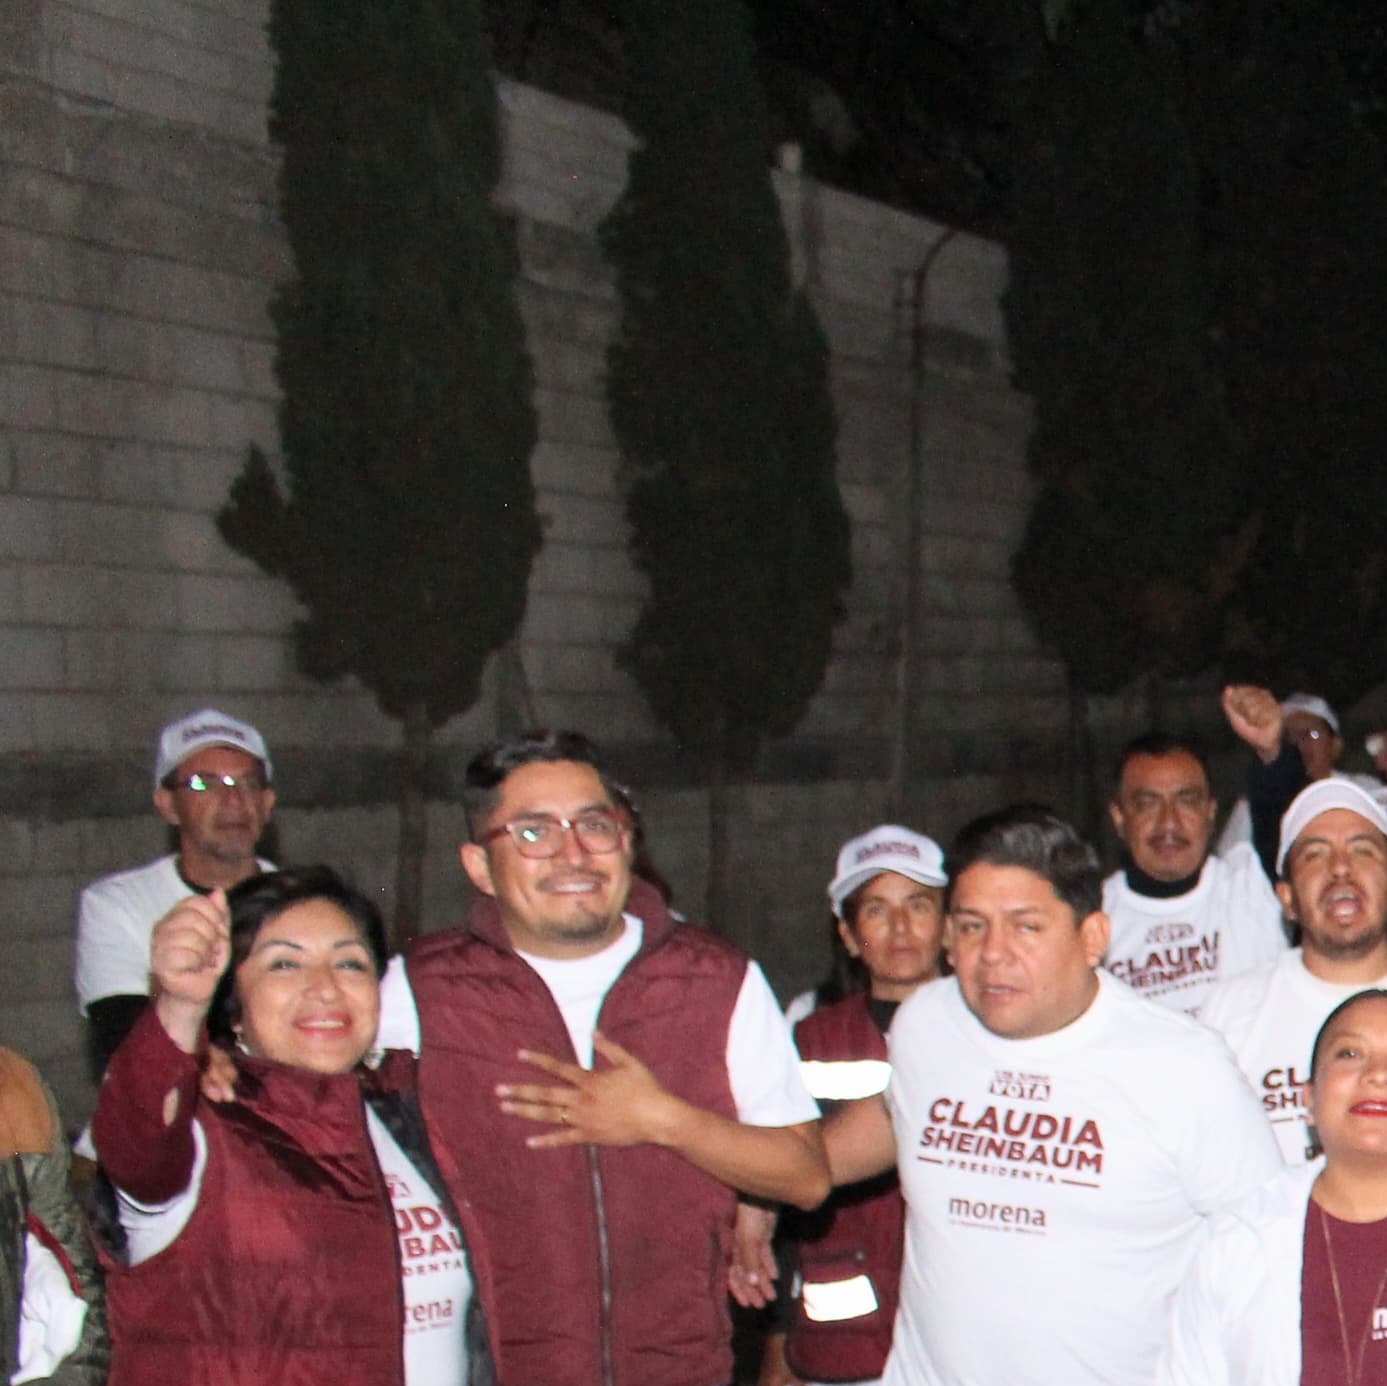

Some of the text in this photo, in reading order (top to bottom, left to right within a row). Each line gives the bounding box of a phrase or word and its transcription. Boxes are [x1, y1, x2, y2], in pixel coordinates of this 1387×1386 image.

[990, 1081, 1051, 1101] VOTA
[928, 1097, 1104, 1150] CLAUDIA
[919, 1126, 1103, 1174] SHEINBAUM
[947, 1159, 1057, 1184] PRESIDENTA
[949, 1197, 1047, 1228] morena
